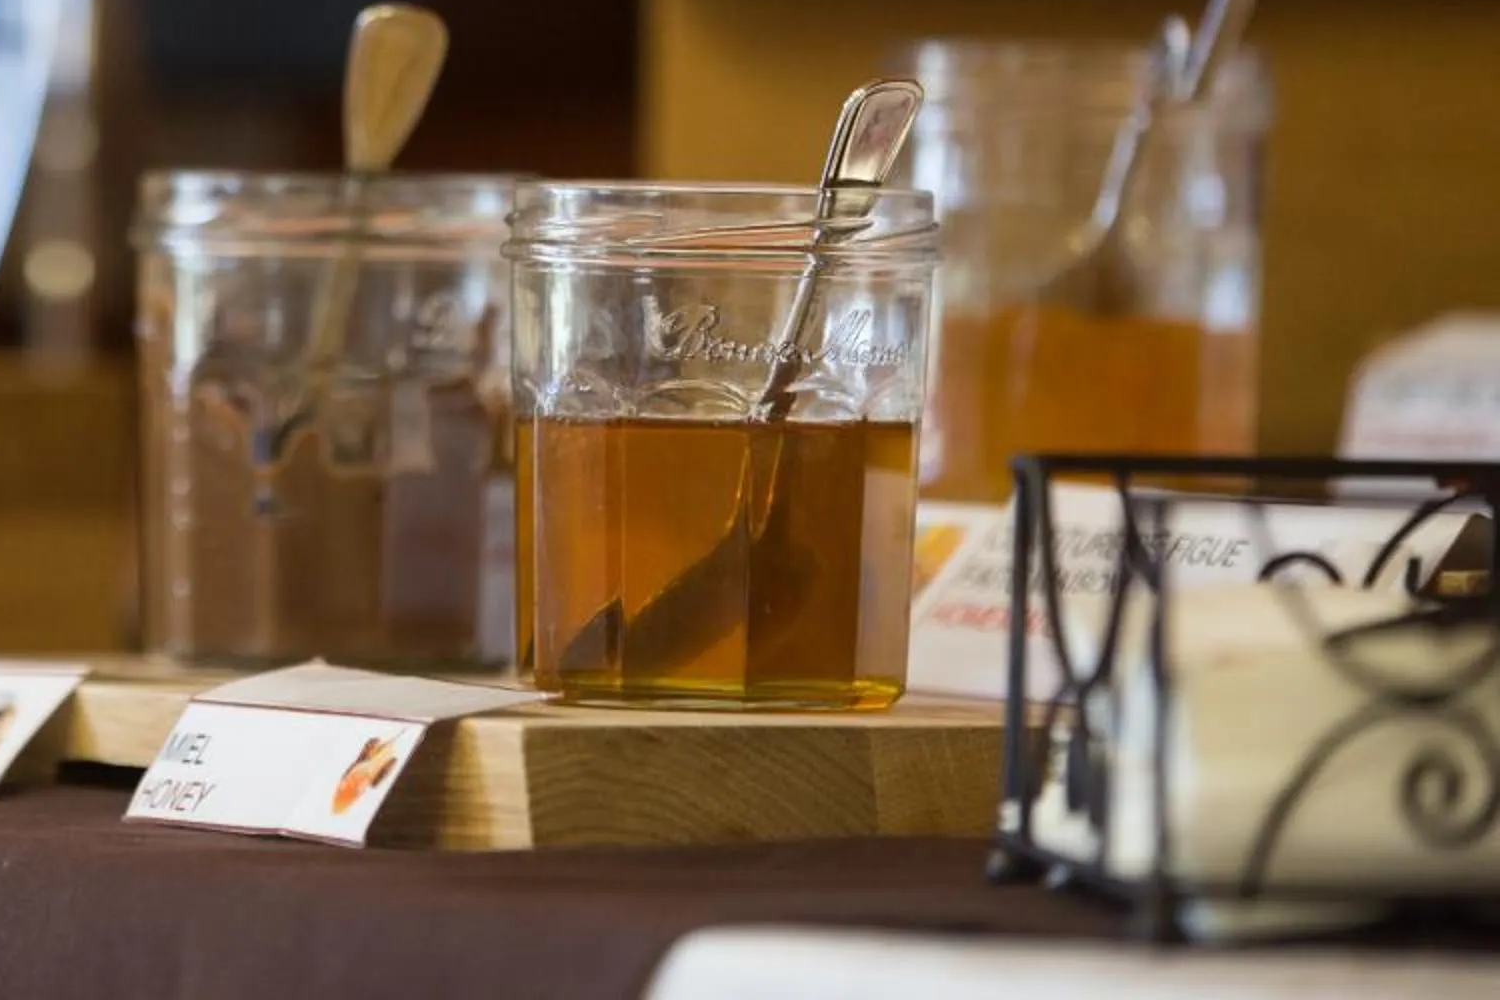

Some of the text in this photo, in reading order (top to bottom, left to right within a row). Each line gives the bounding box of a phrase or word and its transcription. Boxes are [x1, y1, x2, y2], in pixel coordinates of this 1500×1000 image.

[1165, 532, 1249, 569] FIGUE
[165, 732, 212, 765] MIEL
[140, 779, 217, 813] HONEY
